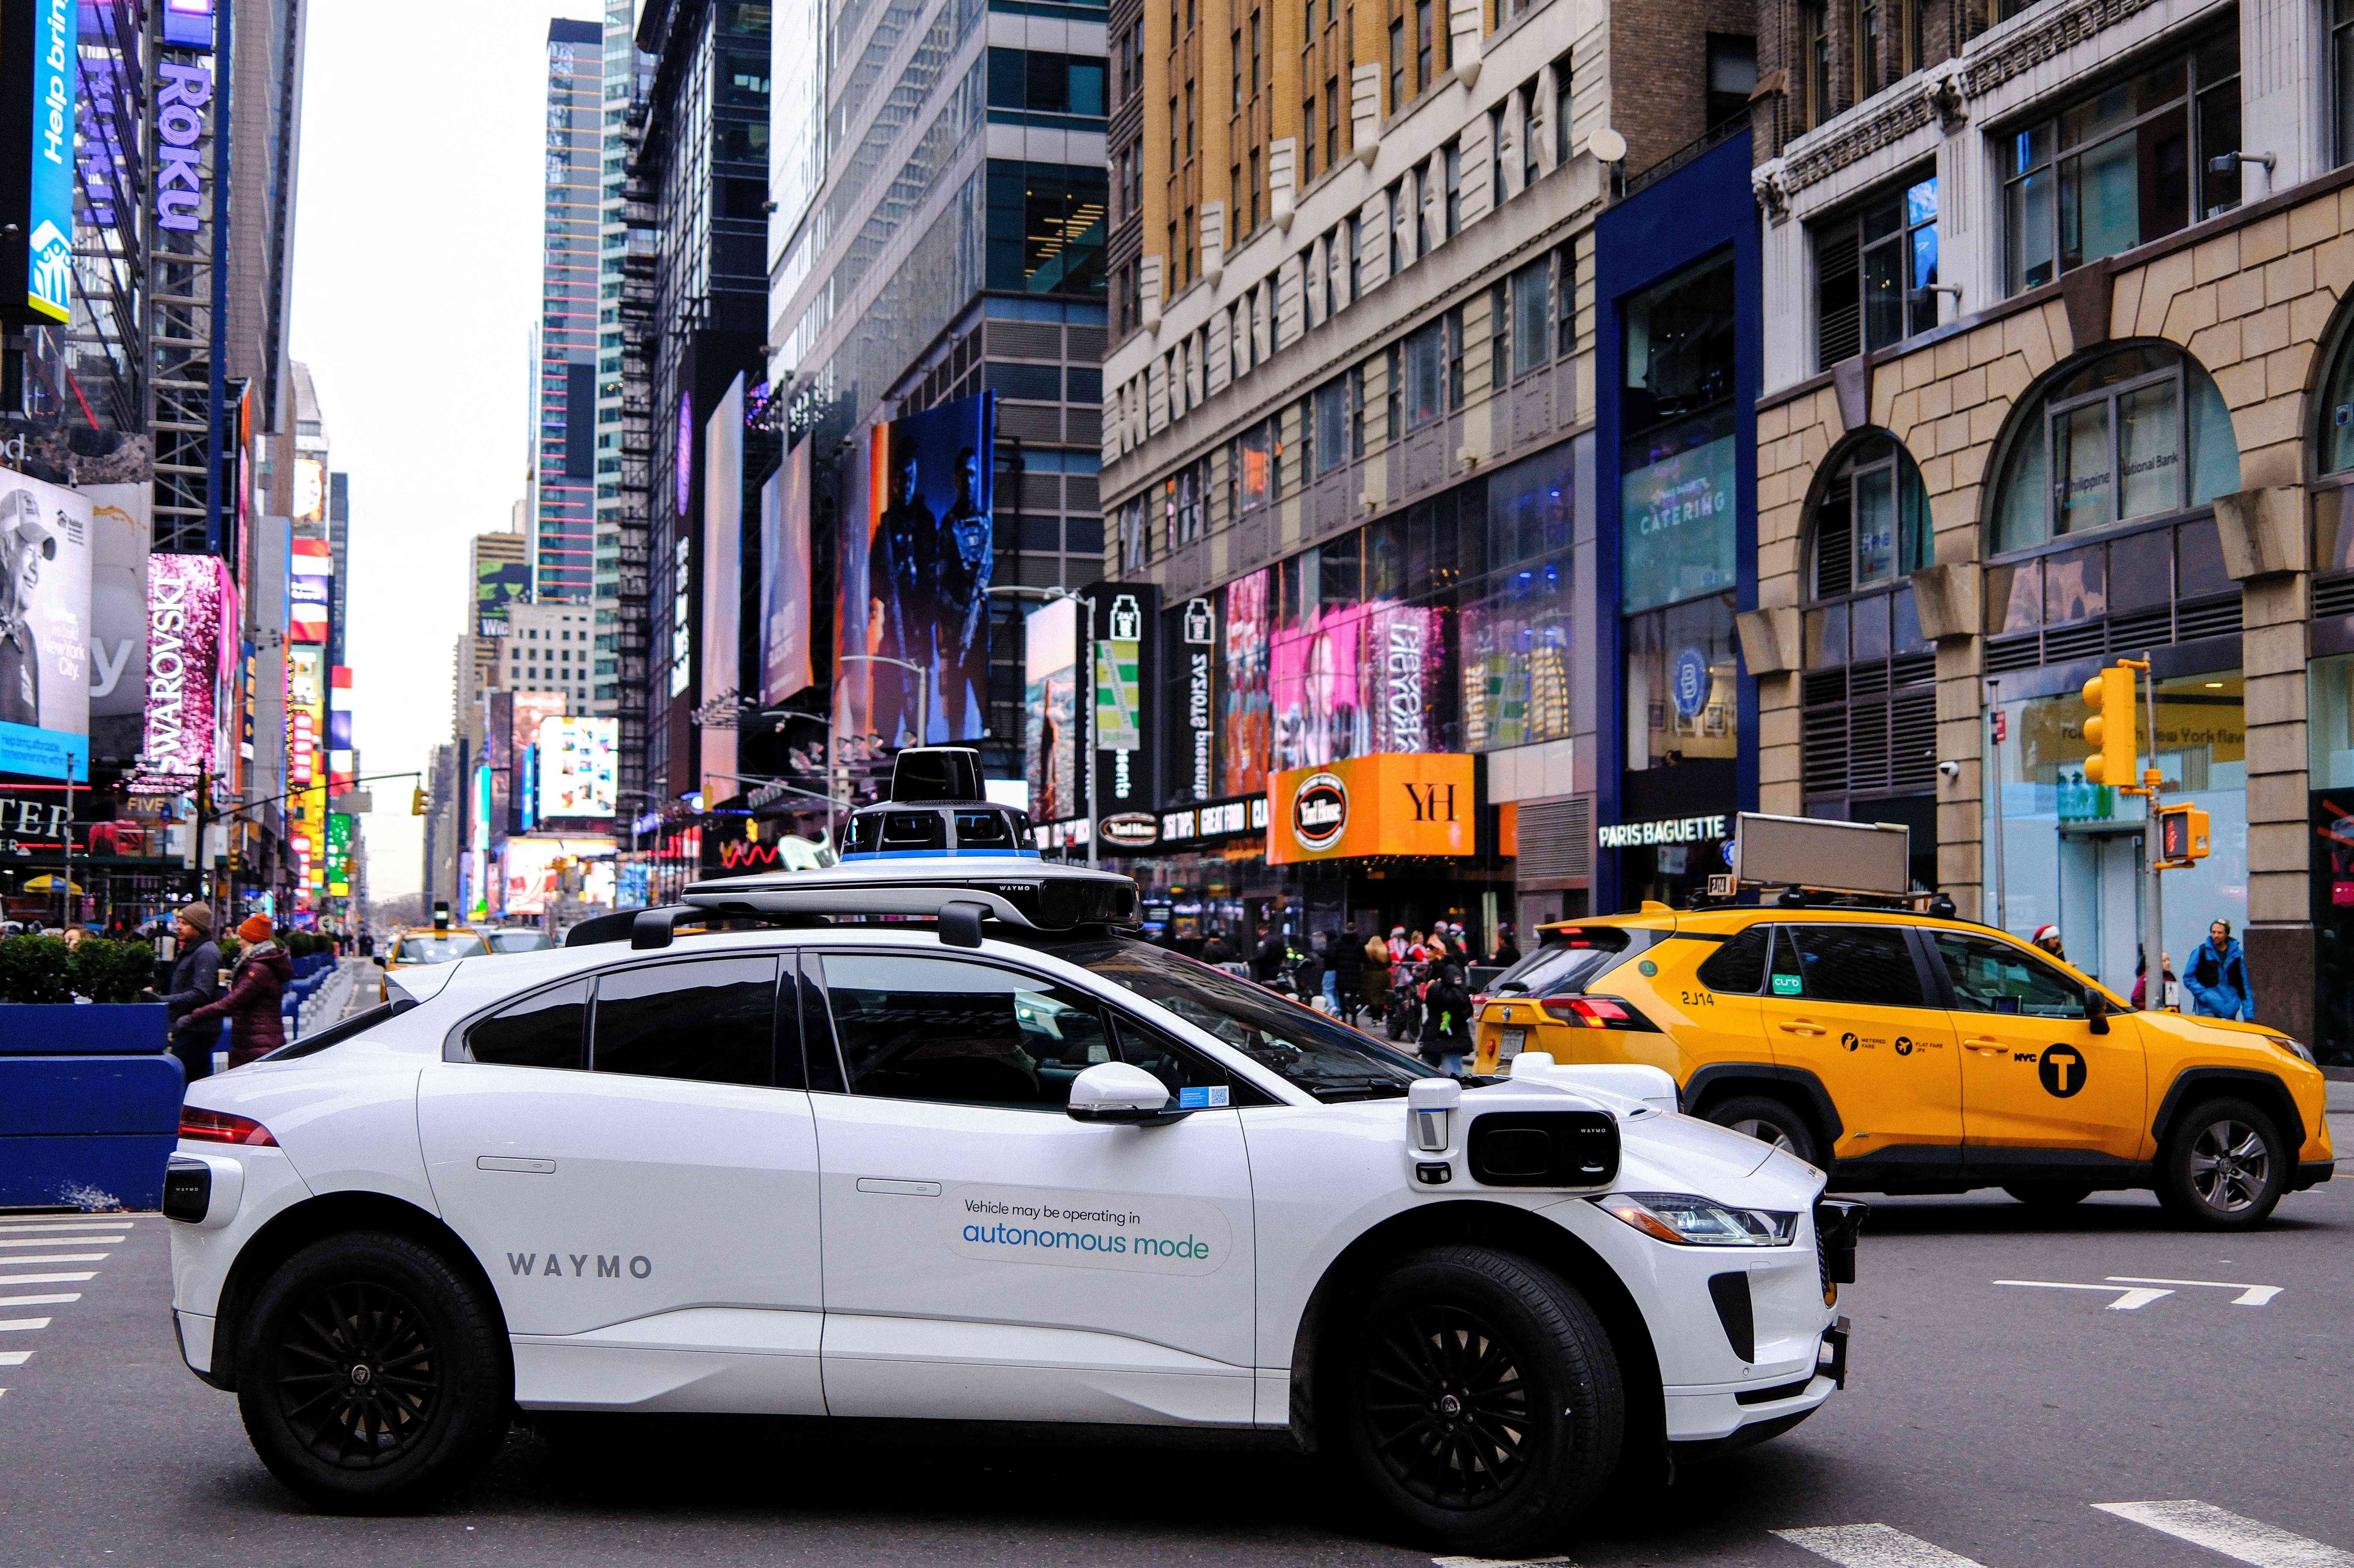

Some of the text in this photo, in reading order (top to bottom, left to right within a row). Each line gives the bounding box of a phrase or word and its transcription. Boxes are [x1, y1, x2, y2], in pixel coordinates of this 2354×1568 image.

[44, 0, 70, 164] Help brin
[1640, 492, 1725, 535] CATERING
[150, 578, 185, 774] SWAROVSKI
[127, 797, 165, 812] FIVE
[1403, 783, 1457, 822] YH
[1599, 815, 1726, 848] PARIS BAGUETTE
[1681, 992, 1714, 1006] 2J14
[1774, 978, 1799, 987] curb
[2014, 1052, 2037, 1063] NYC
[2049, 1054, 2076, 1091] T
[965, 1199, 1140, 1225] Vehicle may be operating in
[963, 1222, 1209, 1259] autonomous mode
[507, 1252, 652, 1279] WAYMO
